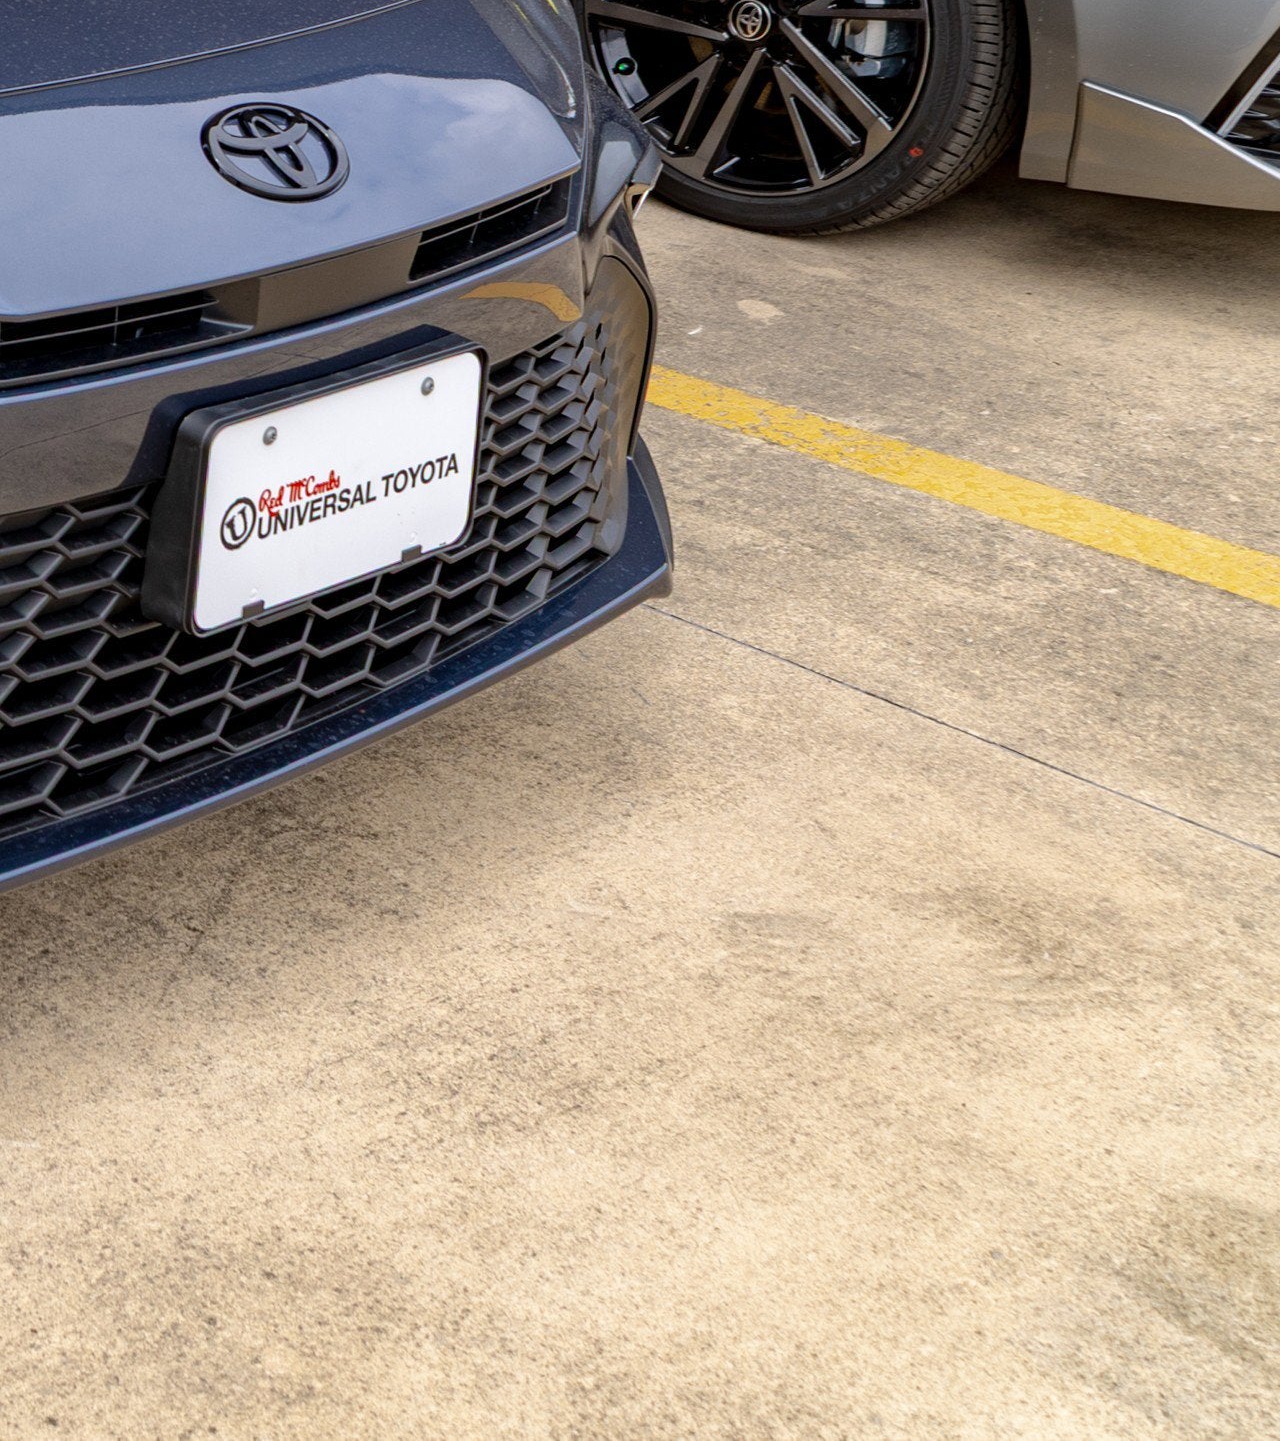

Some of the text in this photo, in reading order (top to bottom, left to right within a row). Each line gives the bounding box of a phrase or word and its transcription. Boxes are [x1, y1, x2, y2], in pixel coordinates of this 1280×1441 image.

[258, 470, 341, 517] Red McCombs
[258, 453, 459, 539] UNIVERSAL TOYOTA
